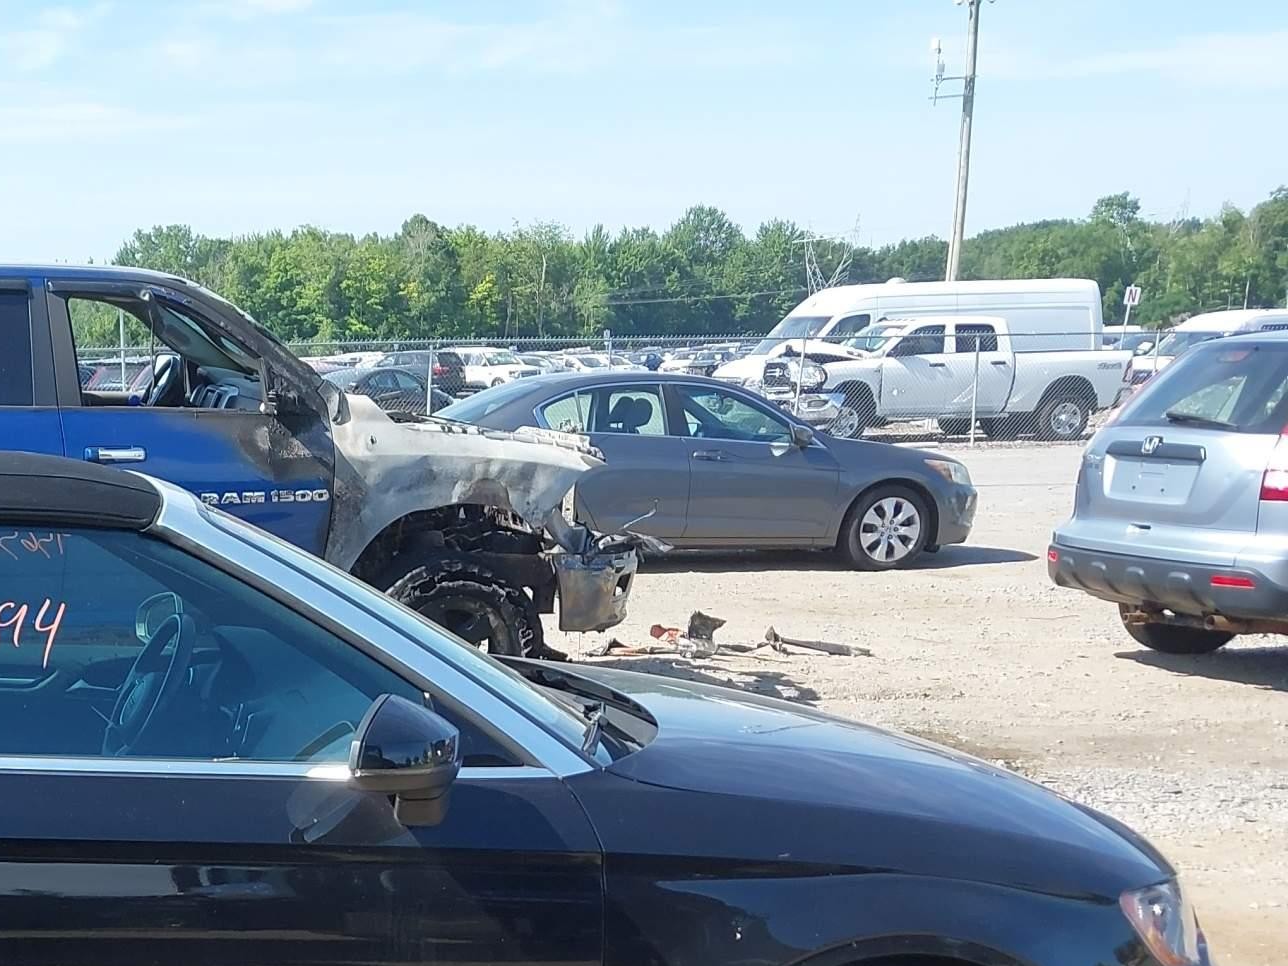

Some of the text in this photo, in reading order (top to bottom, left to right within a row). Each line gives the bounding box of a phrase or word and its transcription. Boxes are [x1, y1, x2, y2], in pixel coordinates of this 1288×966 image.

[1127, 288, 1138, 303] N
[200, 488, 330, 505] RAM 1500
